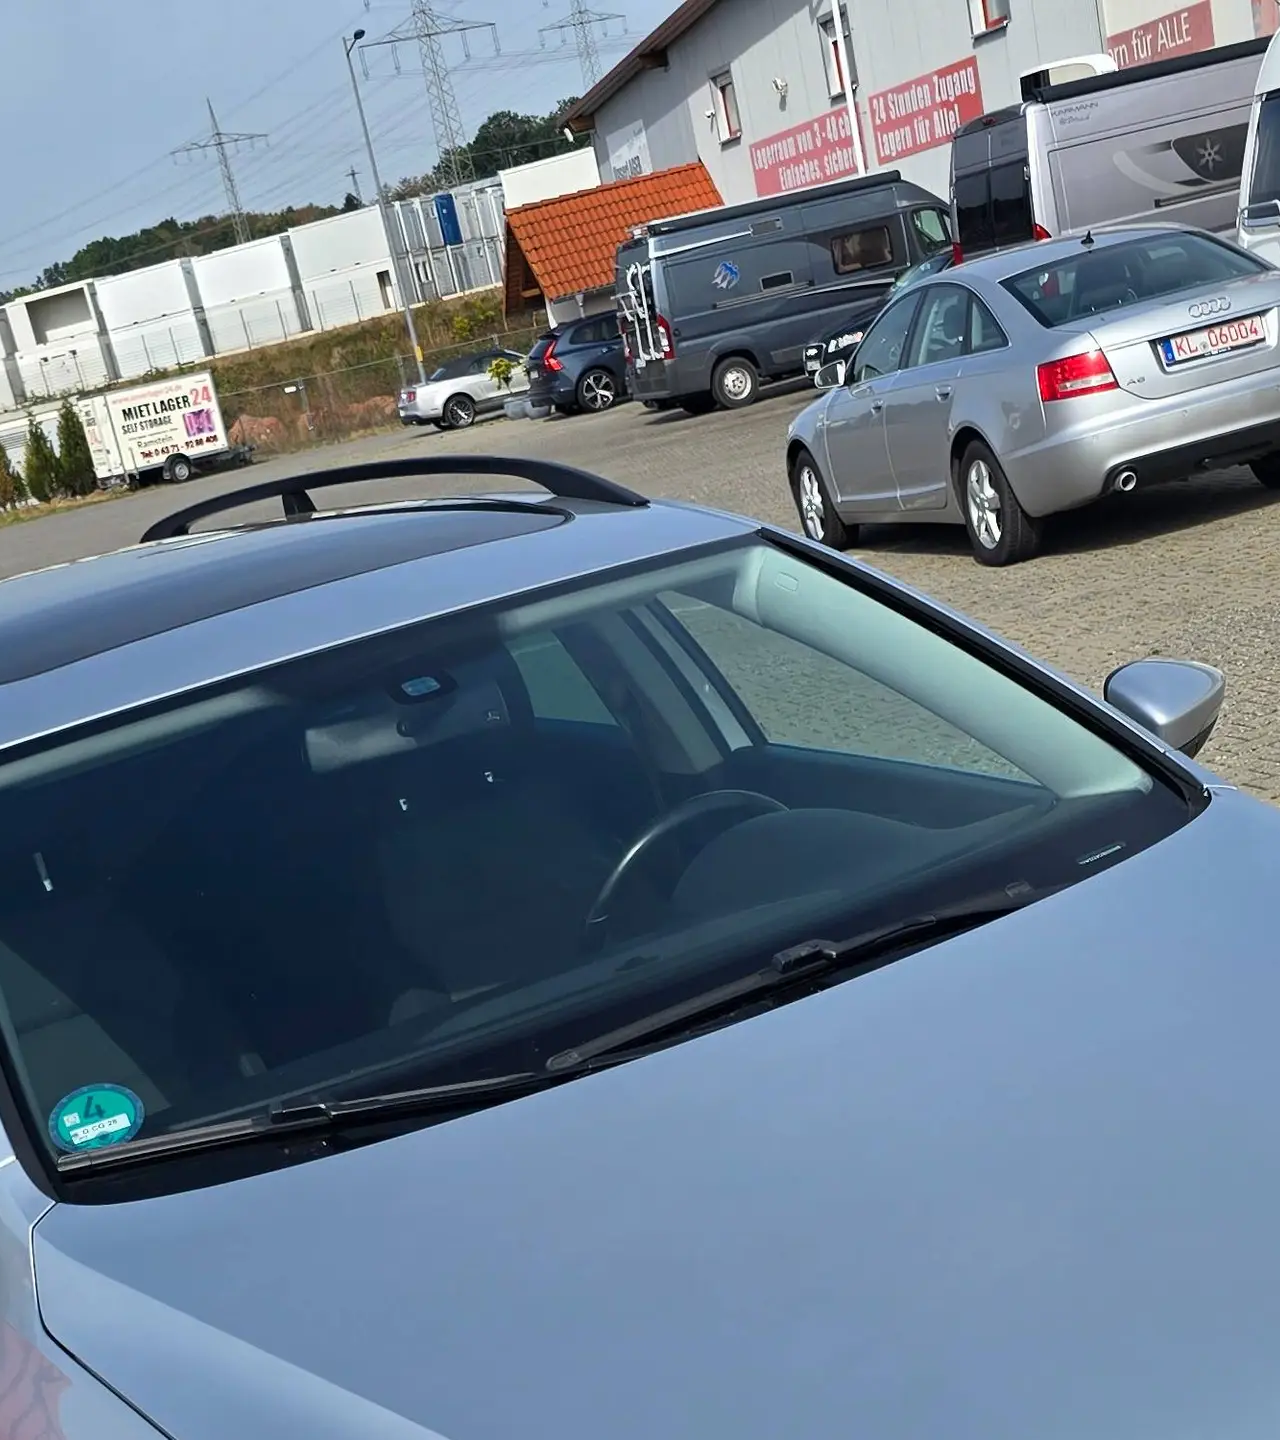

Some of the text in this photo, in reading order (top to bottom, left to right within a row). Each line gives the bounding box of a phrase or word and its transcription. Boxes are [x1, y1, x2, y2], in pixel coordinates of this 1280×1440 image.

[1131, 29, 1152, 61] für
[1157, 12, 1192, 52] ALLE
[872, 65, 976, 126] 24 Stunden Zugang
[1050, 102, 1099, 117] KARMANN
[751, 136, 797, 170] Lagerraum
[796, 129, 814, 154] von
[838, 111, 852, 139] cb
[877, 103, 961, 157] Lagern für Alle!
[778, 159, 824, 191] Einfaches,
[1174, 336, 1198, 357] KL
[1207, 319, 1259, 348] 06004
[1126, 376, 1146, 386] A6
[121, 402, 151, 422] MIET
[153, 395, 191, 415] LAGER
[190, 385, 212, 406] 24
[121, 422, 138, 435] SELF
[139, 415, 173, 431] STORAGE
[136, 435, 173, 448] Ramstein
[83, 1095, 106, 1119] 4
